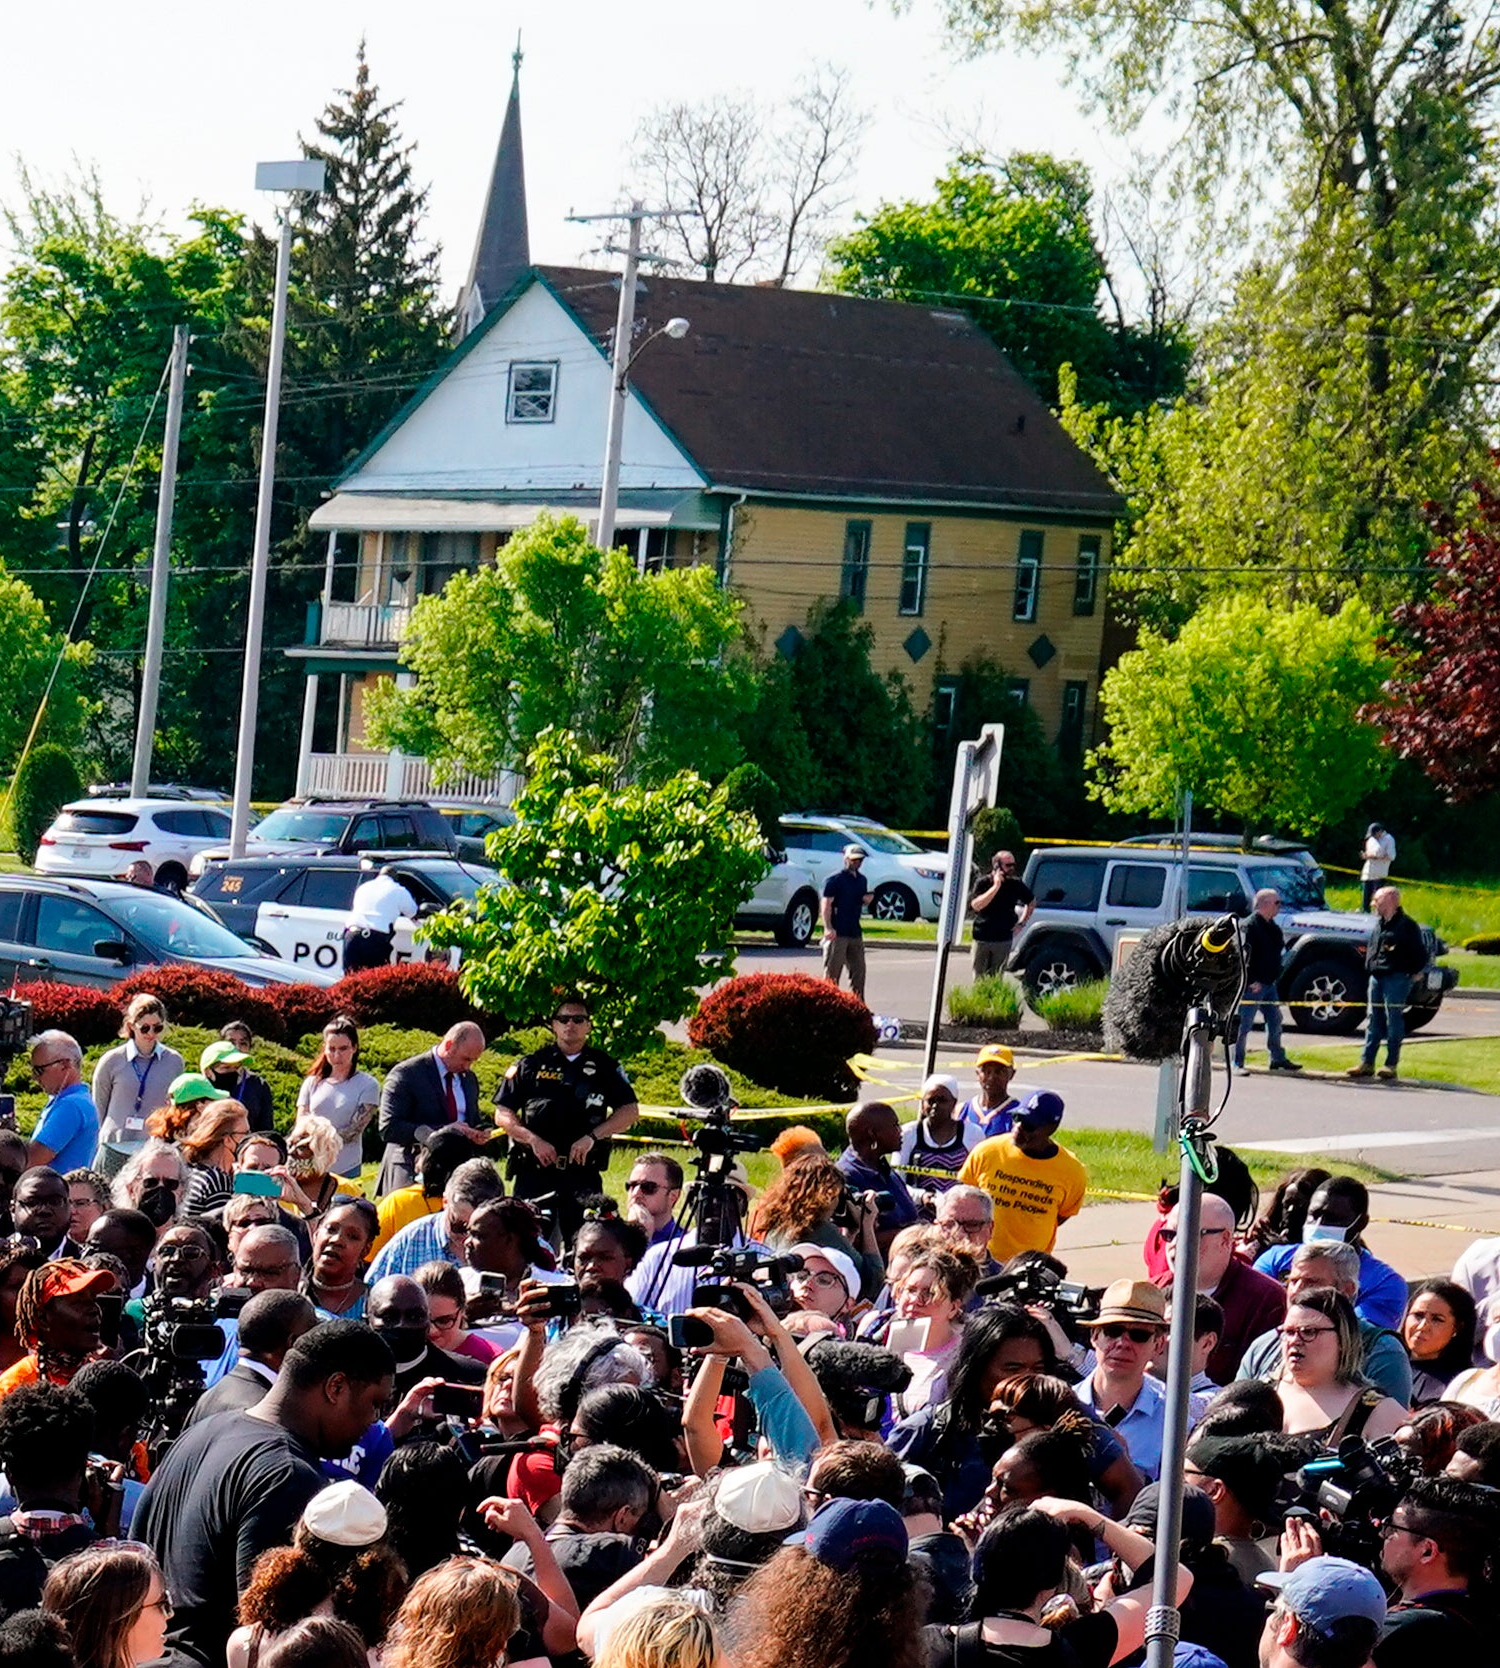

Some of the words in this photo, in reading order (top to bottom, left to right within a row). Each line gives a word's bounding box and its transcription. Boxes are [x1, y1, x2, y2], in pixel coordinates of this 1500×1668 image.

[220, 879, 243, 893] 245
[536, 1070, 564, 1080] POLICE
[995, 1169, 1053, 1192] Responding
[1000, 1183, 1017, 1196] the
[1019, 1190, 1054, 1205] needs
[995, 1197, 1010, 1208] the
[1013, 1200, 1048, 1215] People
